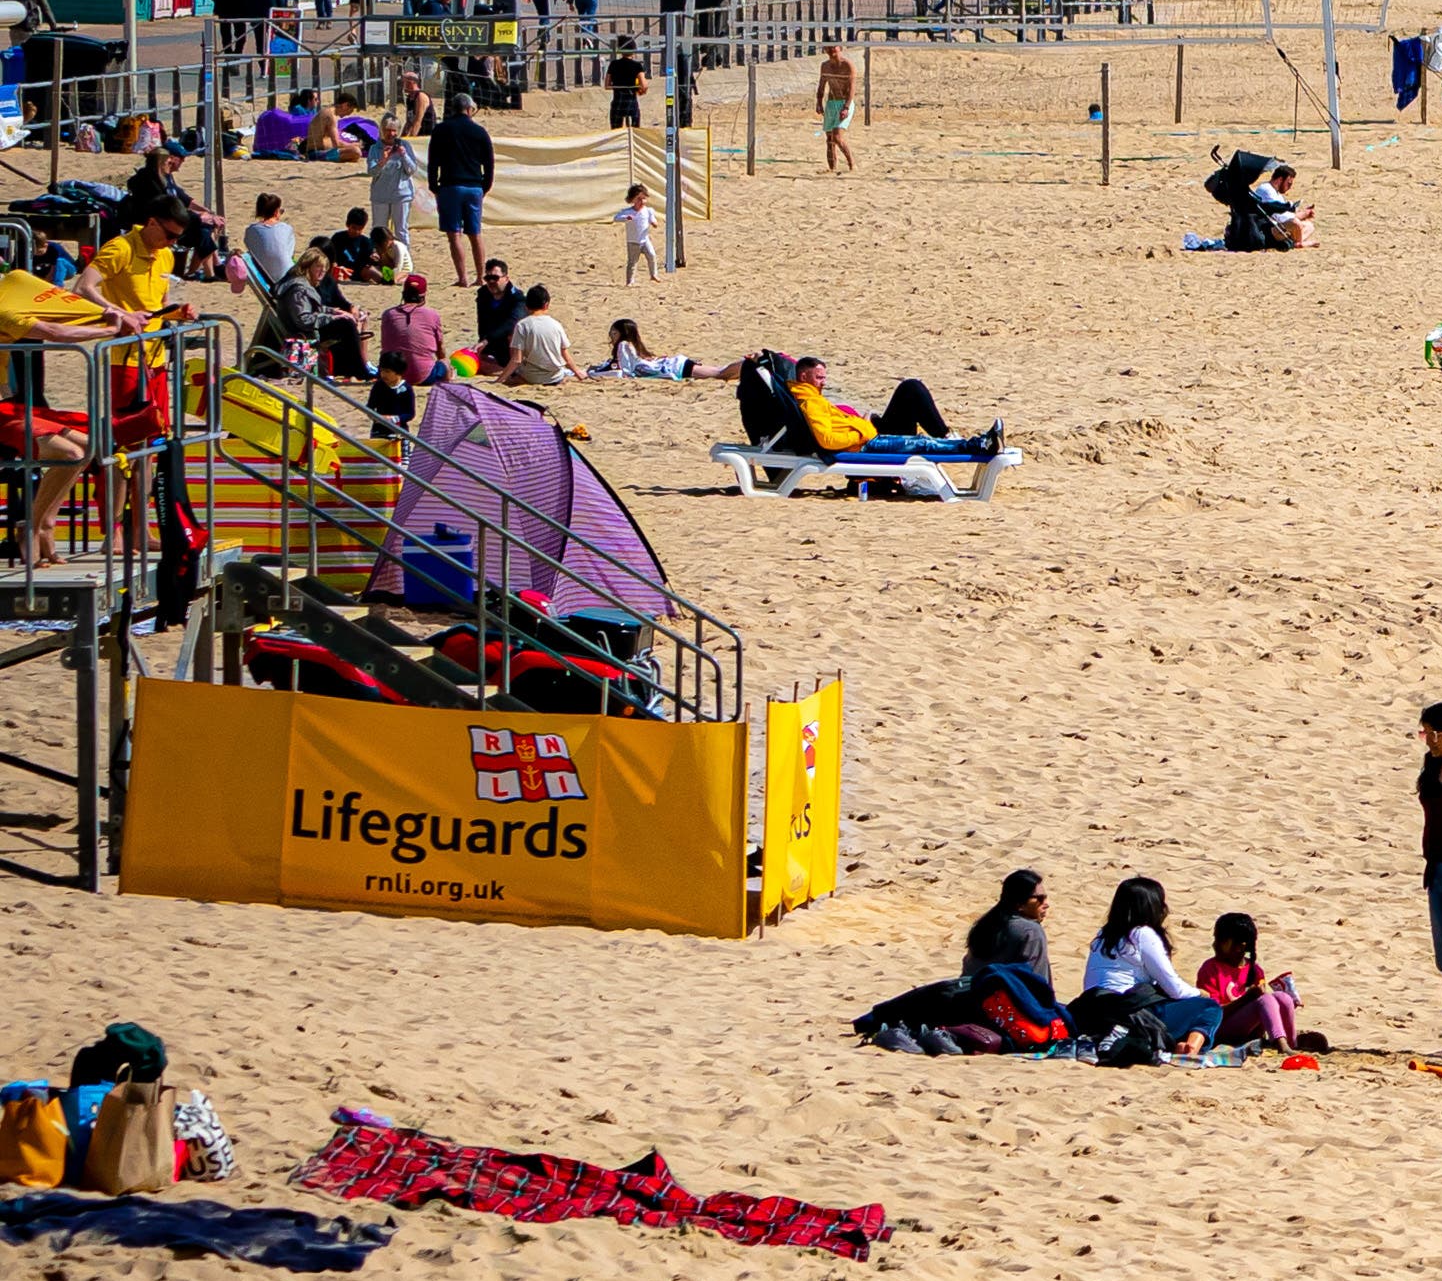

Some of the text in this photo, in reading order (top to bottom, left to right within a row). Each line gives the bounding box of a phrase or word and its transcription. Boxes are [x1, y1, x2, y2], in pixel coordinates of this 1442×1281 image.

[400, 25, 440, 37] THREE
[445, 24, 484, 37] SIXTY
[292, 789, 587, 864] Lifeguards
[365, 872, 505, 902] rnli.org.uk
